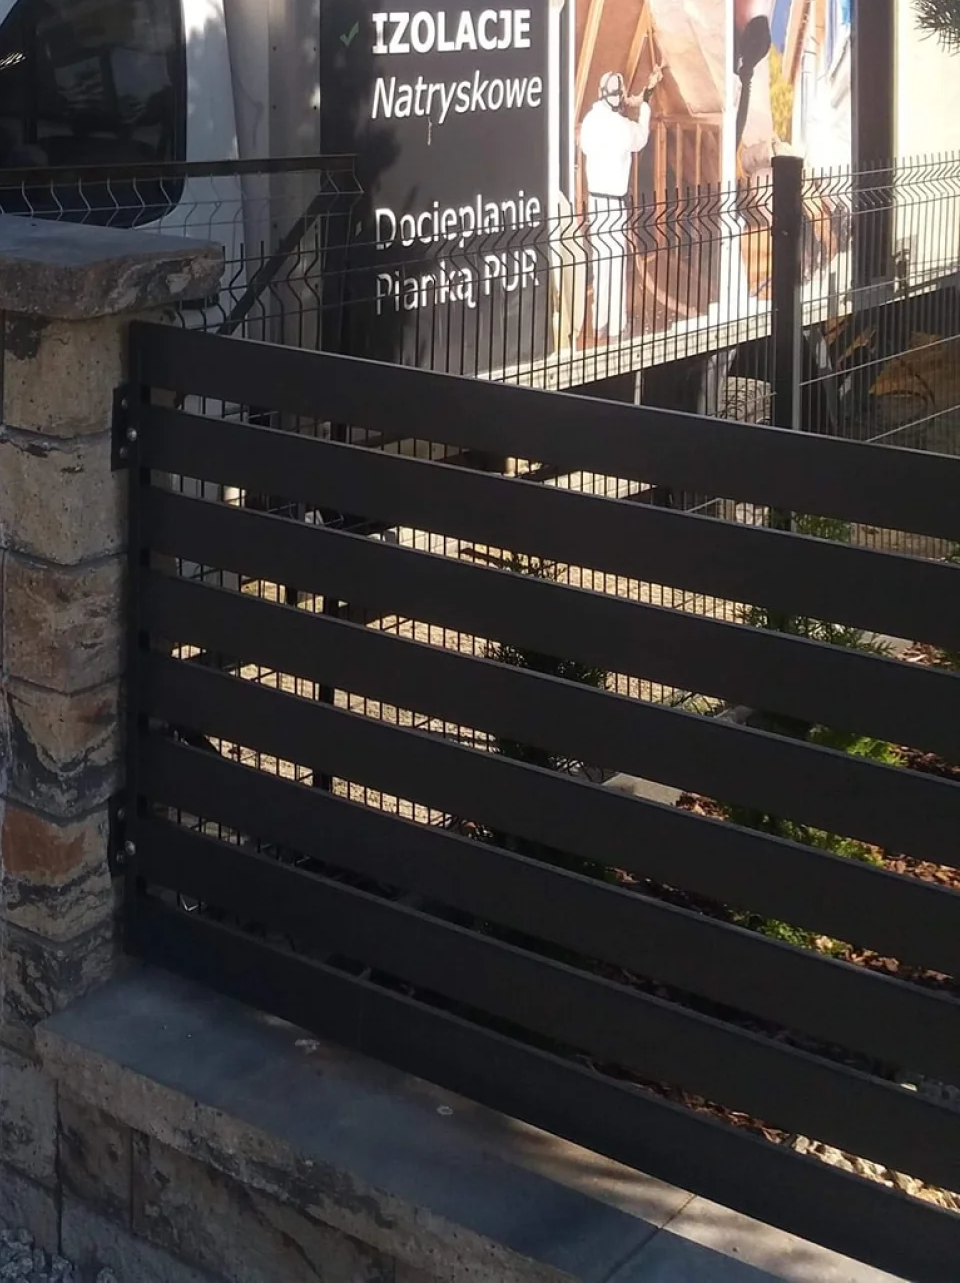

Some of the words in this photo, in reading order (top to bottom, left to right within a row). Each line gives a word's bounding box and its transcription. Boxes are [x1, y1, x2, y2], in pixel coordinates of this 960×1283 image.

[372, 9, 531, 54] IZOLACJE
[371, 69, 542, 124] Natryskowe
[375, 190, 541, 251] Docieplanie
[376, 261, 476, 316] Pianką
[484, 248, 540, 296] PUR
